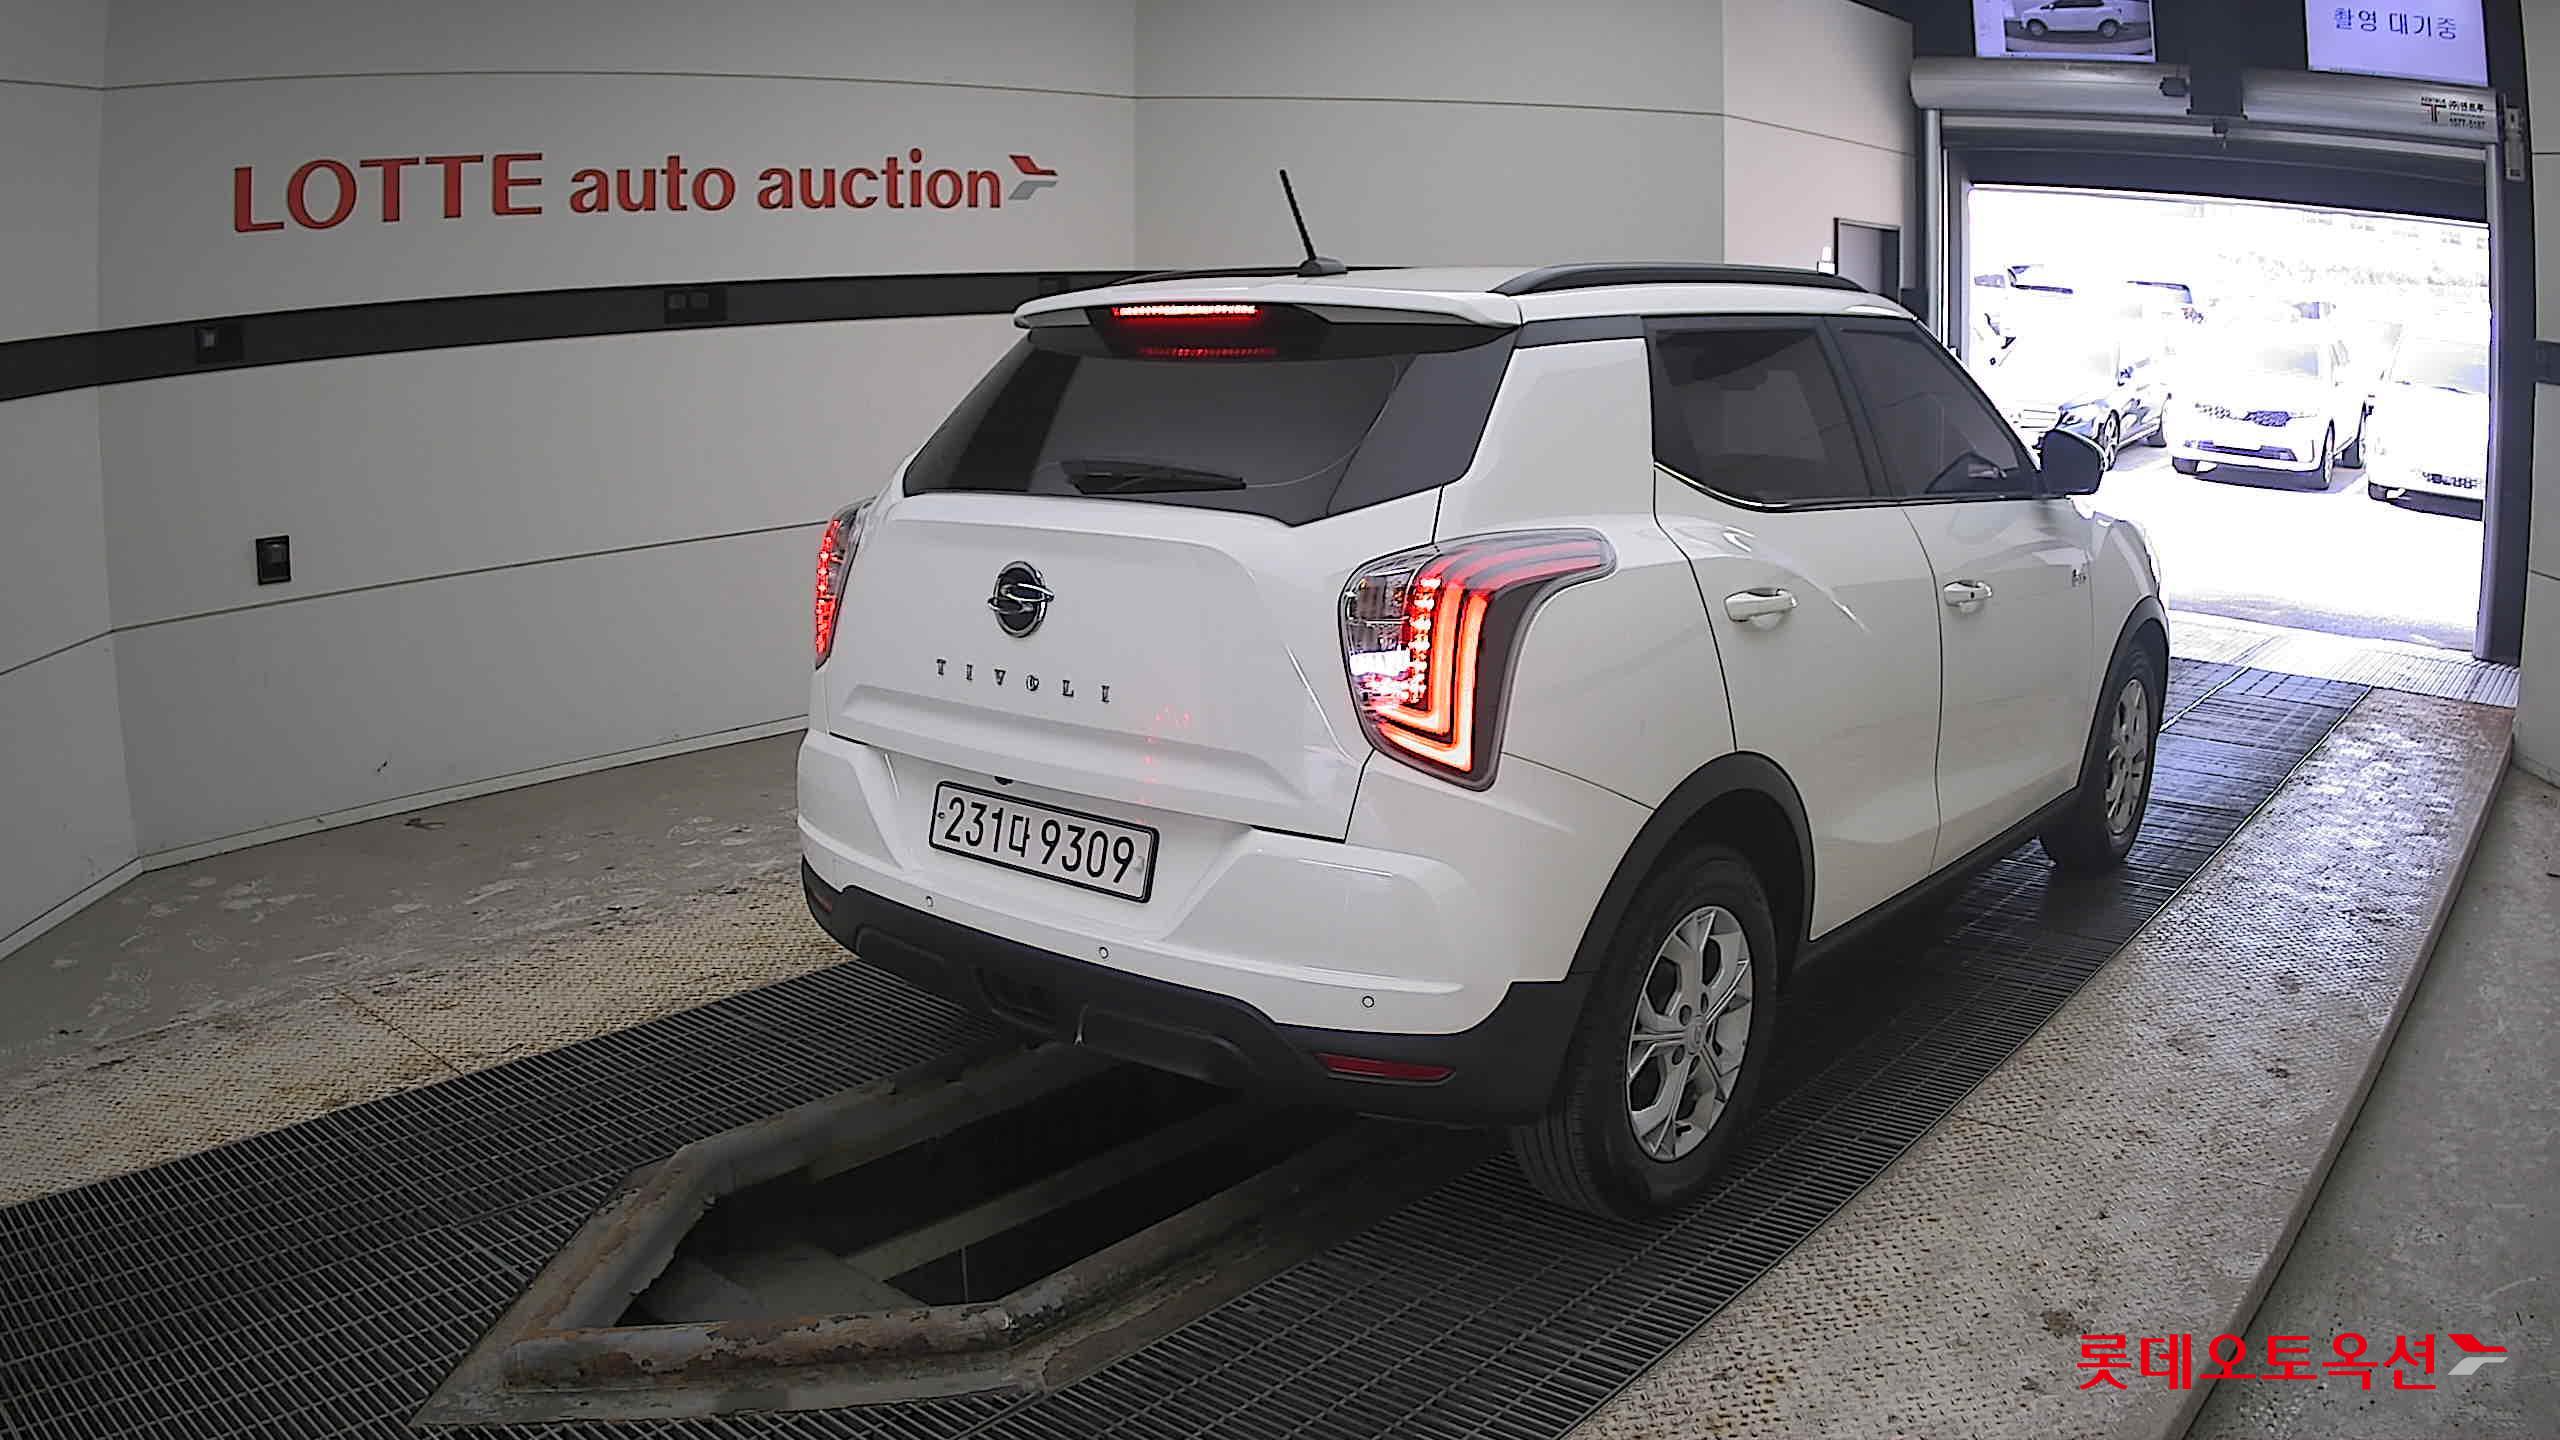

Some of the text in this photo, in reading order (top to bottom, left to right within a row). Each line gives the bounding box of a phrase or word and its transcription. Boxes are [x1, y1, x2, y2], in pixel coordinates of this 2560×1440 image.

[2389, 12, 2457, 40] 대기중
[233, 147, 1002, 233] LOTTE auto auction
[935, 657, 1112, 704] TIVOLI
[1040, 819, 1135, 884] 9309
